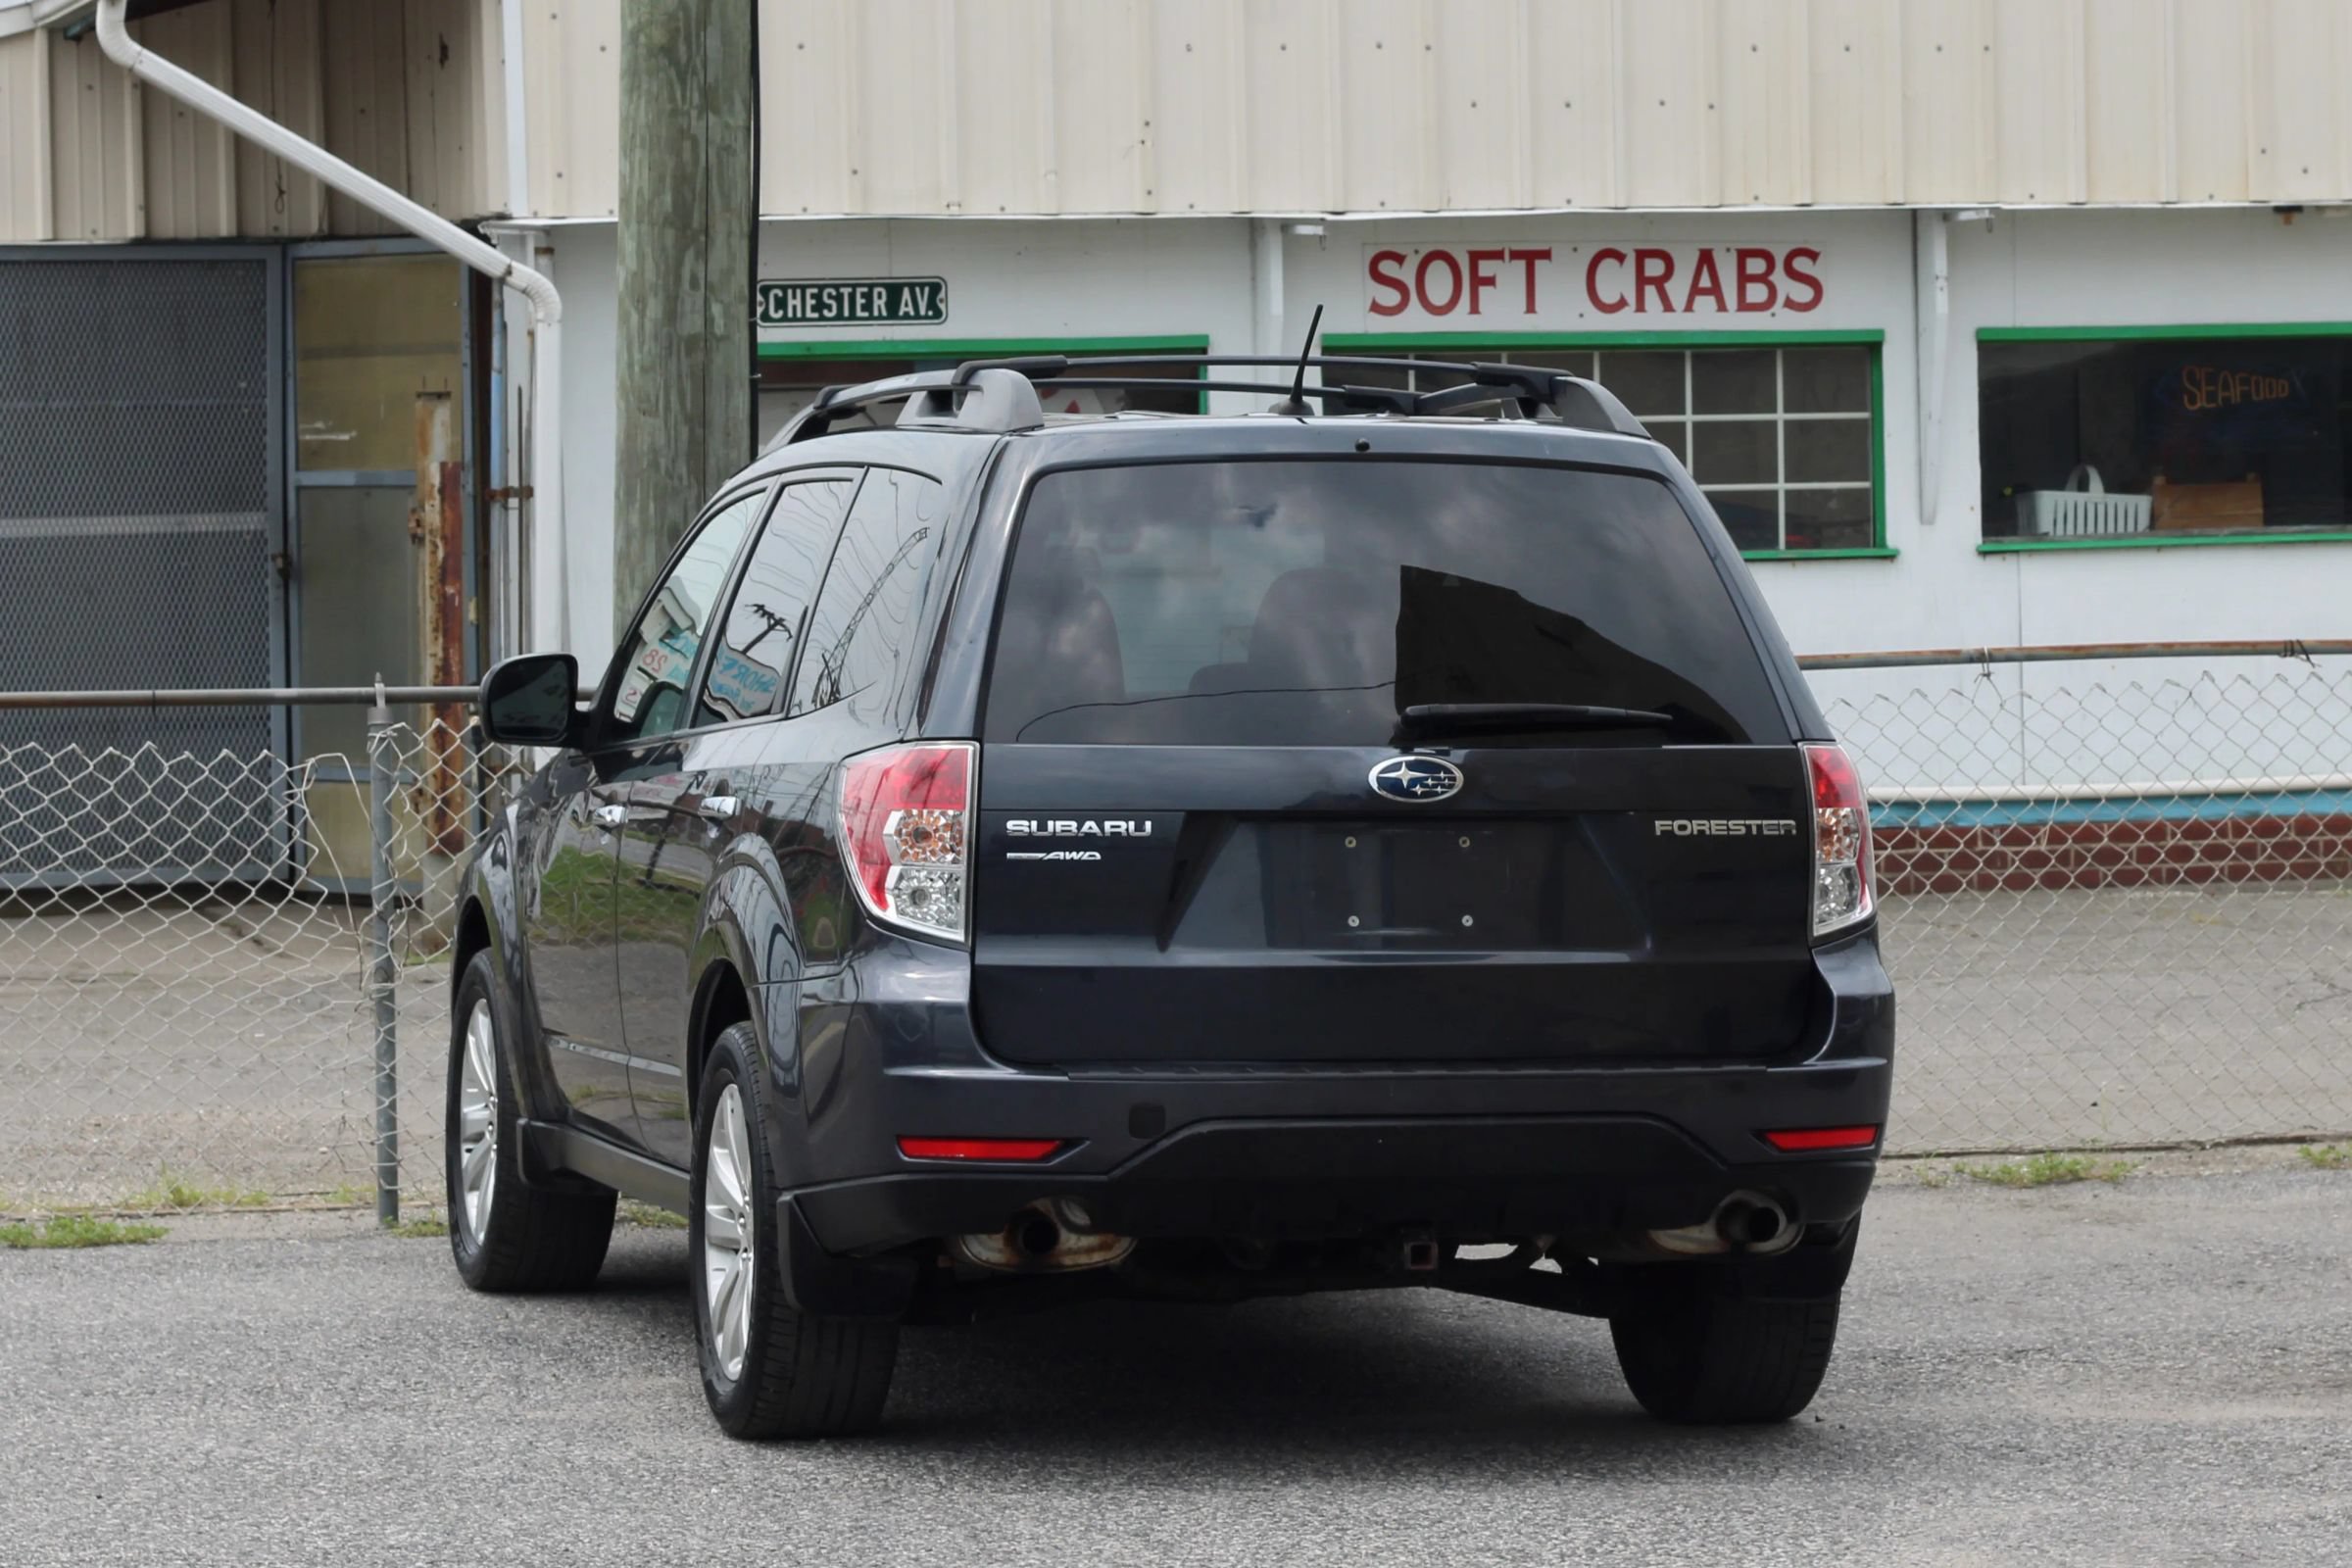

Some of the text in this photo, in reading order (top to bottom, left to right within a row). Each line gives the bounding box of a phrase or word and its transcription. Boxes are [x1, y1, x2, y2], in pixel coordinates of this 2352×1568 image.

[1368, 246, 1825, 317] SOFT CRABS
[768, 285, 934, 318] CHESTER AV.
[2181, 365, 2290, 411] SEAFOOD
[1005, 819, 1152, 837] SUBARU
[1654, 819, 1797, 836] FORESTER
[1042, 851, 1102, 860] AWD
